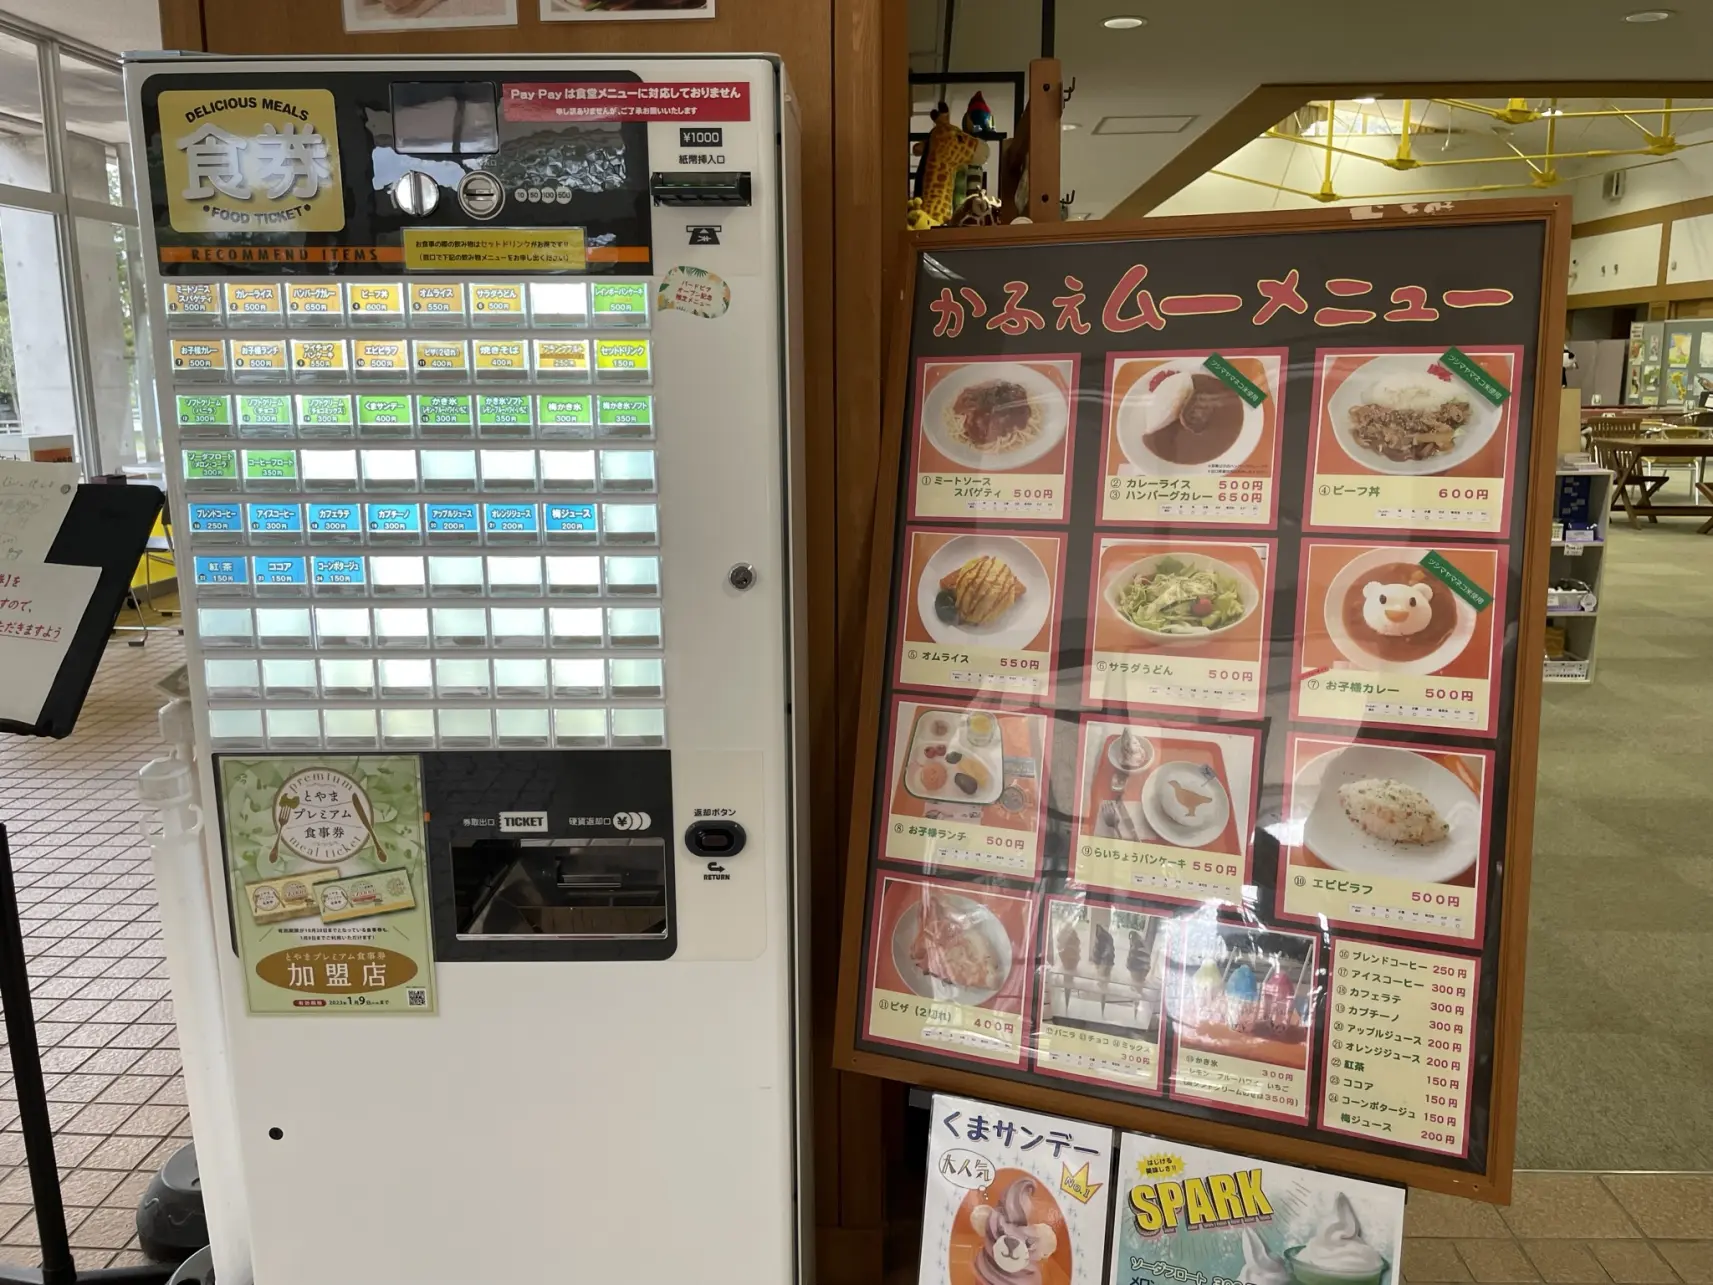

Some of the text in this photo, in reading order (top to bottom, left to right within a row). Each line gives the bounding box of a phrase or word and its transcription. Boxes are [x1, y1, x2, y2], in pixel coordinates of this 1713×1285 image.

[511, 88, 741, 100] Pay Pay は食堂メニューに対応しておりません
[185, 97, 309, 123] DELICIOUS MEALS
[683, 132, 719, 143] ¥1000
[176, 123, 329, 200] 食券
[679, 155, 725, 164] 紙幣挿入口
[212, 206, 303, 225] FOOD TICKET
[192, 250, 378, 260] RECOMMEND ITEMS
[176, 285, 210, 294] ミートソース
[235, 290, 273, 299] カレーライス
[293, 289, 336, 298] ハンバーグカレー
[419, 289, 454, 298] オムライス
[477, 289, 517, 299] サラダうどん
[181, 346, 218, 355] お子様カレー
[480, 346, 519, 355] 焼きそば
[600, 346, 644, 355] セットドリンク
[364, 402, 405, 411] くまサンデー
[432, 397, 457, 406] かき氷
[548, 403, 581, 412] 梅かき氷
[934, 476, 991, 486] ミートソース
[1126, 479, 1263, 490] カレーライス 500円
[954, 488, 1053, 499] スパゲティ 500円
[1126, 490, 1262, 503] ハンバーグカレー 650円
[1333, 486, 1489, 500] ビーフ丼 600円
[196, 509, 237, 519] ブレンドコーヒー
[257, 510, 294, 519] アイスコーヒー
[319, 509, 350, 519] カフェラテ
[432, 509, 473, 519] アップルジュース
[491, 509, 532, 519] オレンジジュース
[552, 509, 591, 519] 梅ジュース
[325, 522, 346, 530] 300円
[384, 522, 406, 530] 300円
[443, 522, 464, 530] 200円
[502, 522, 524, 530] 200円
[561, 522, 583, 530] 200円
[208, 562, 233, 571] 紅茶
[268, 562, 292, 571] ココア
[318, 561, 359, 571] コーンポタージュ
[922, 652, 1039, 670] オムライス 550円
[1109, 662, 1252, 682] サラダうどん 500円
[1326, 681, 1473, 701] お子様カレー 500円
[289, 772, 354, 793] premium
[304, 790, 339, 802] とやま
[294, 809, 352, 820] プレミアム
[694, 808, 736, 817] 返却ボタン
[504, 816, 544, 827] TICKET
[304, 826, 345, 839] 食事券
[909, 826, 1024, 850] お子様ランチ 500円
[289, 836, 362, 858] meal ticket
[1094, 847, 1237, 876] らいちょうパンケーキ 550円
[1312, 878, 1460, 907] エビピラフ 500円
[285, 951, 386, 961] とやまプレミアム食事券
[1353, 951, 1427, 970] ブレンドコーヒー
[287, 962, 386, 987] 加盟店
[1352, 969, 1424, 988] アイスコーヒー
[1350, 987, 1401, 1004] カフェラテ
[974, 1018, 1014, 1033] 400円
[1347, 1024, 1422, 1045] アップルジュース
[1346, 1042, 1420, 1063] オレンジジュース
[1344, 1060, 1365, 1072] 紅茶
[1262, 1070, 1294, 1082] 300円
[1343, 1078, 1374, 1091] ココア
[1342, 1096, 1416, 1119] コーンポタージュ
[1341, 1113, 1392, 1132] 梅ジュース
[943, 1111, 1100, 1158] くまサンデー
[941, 1154, 991, 1182] 大人気
[1064, 1176, 1090, 1197] No.1
[1129, 1168, 1274, 1235] SPARK
[1130, 1256, 1207, 1285] ソーダフロート
